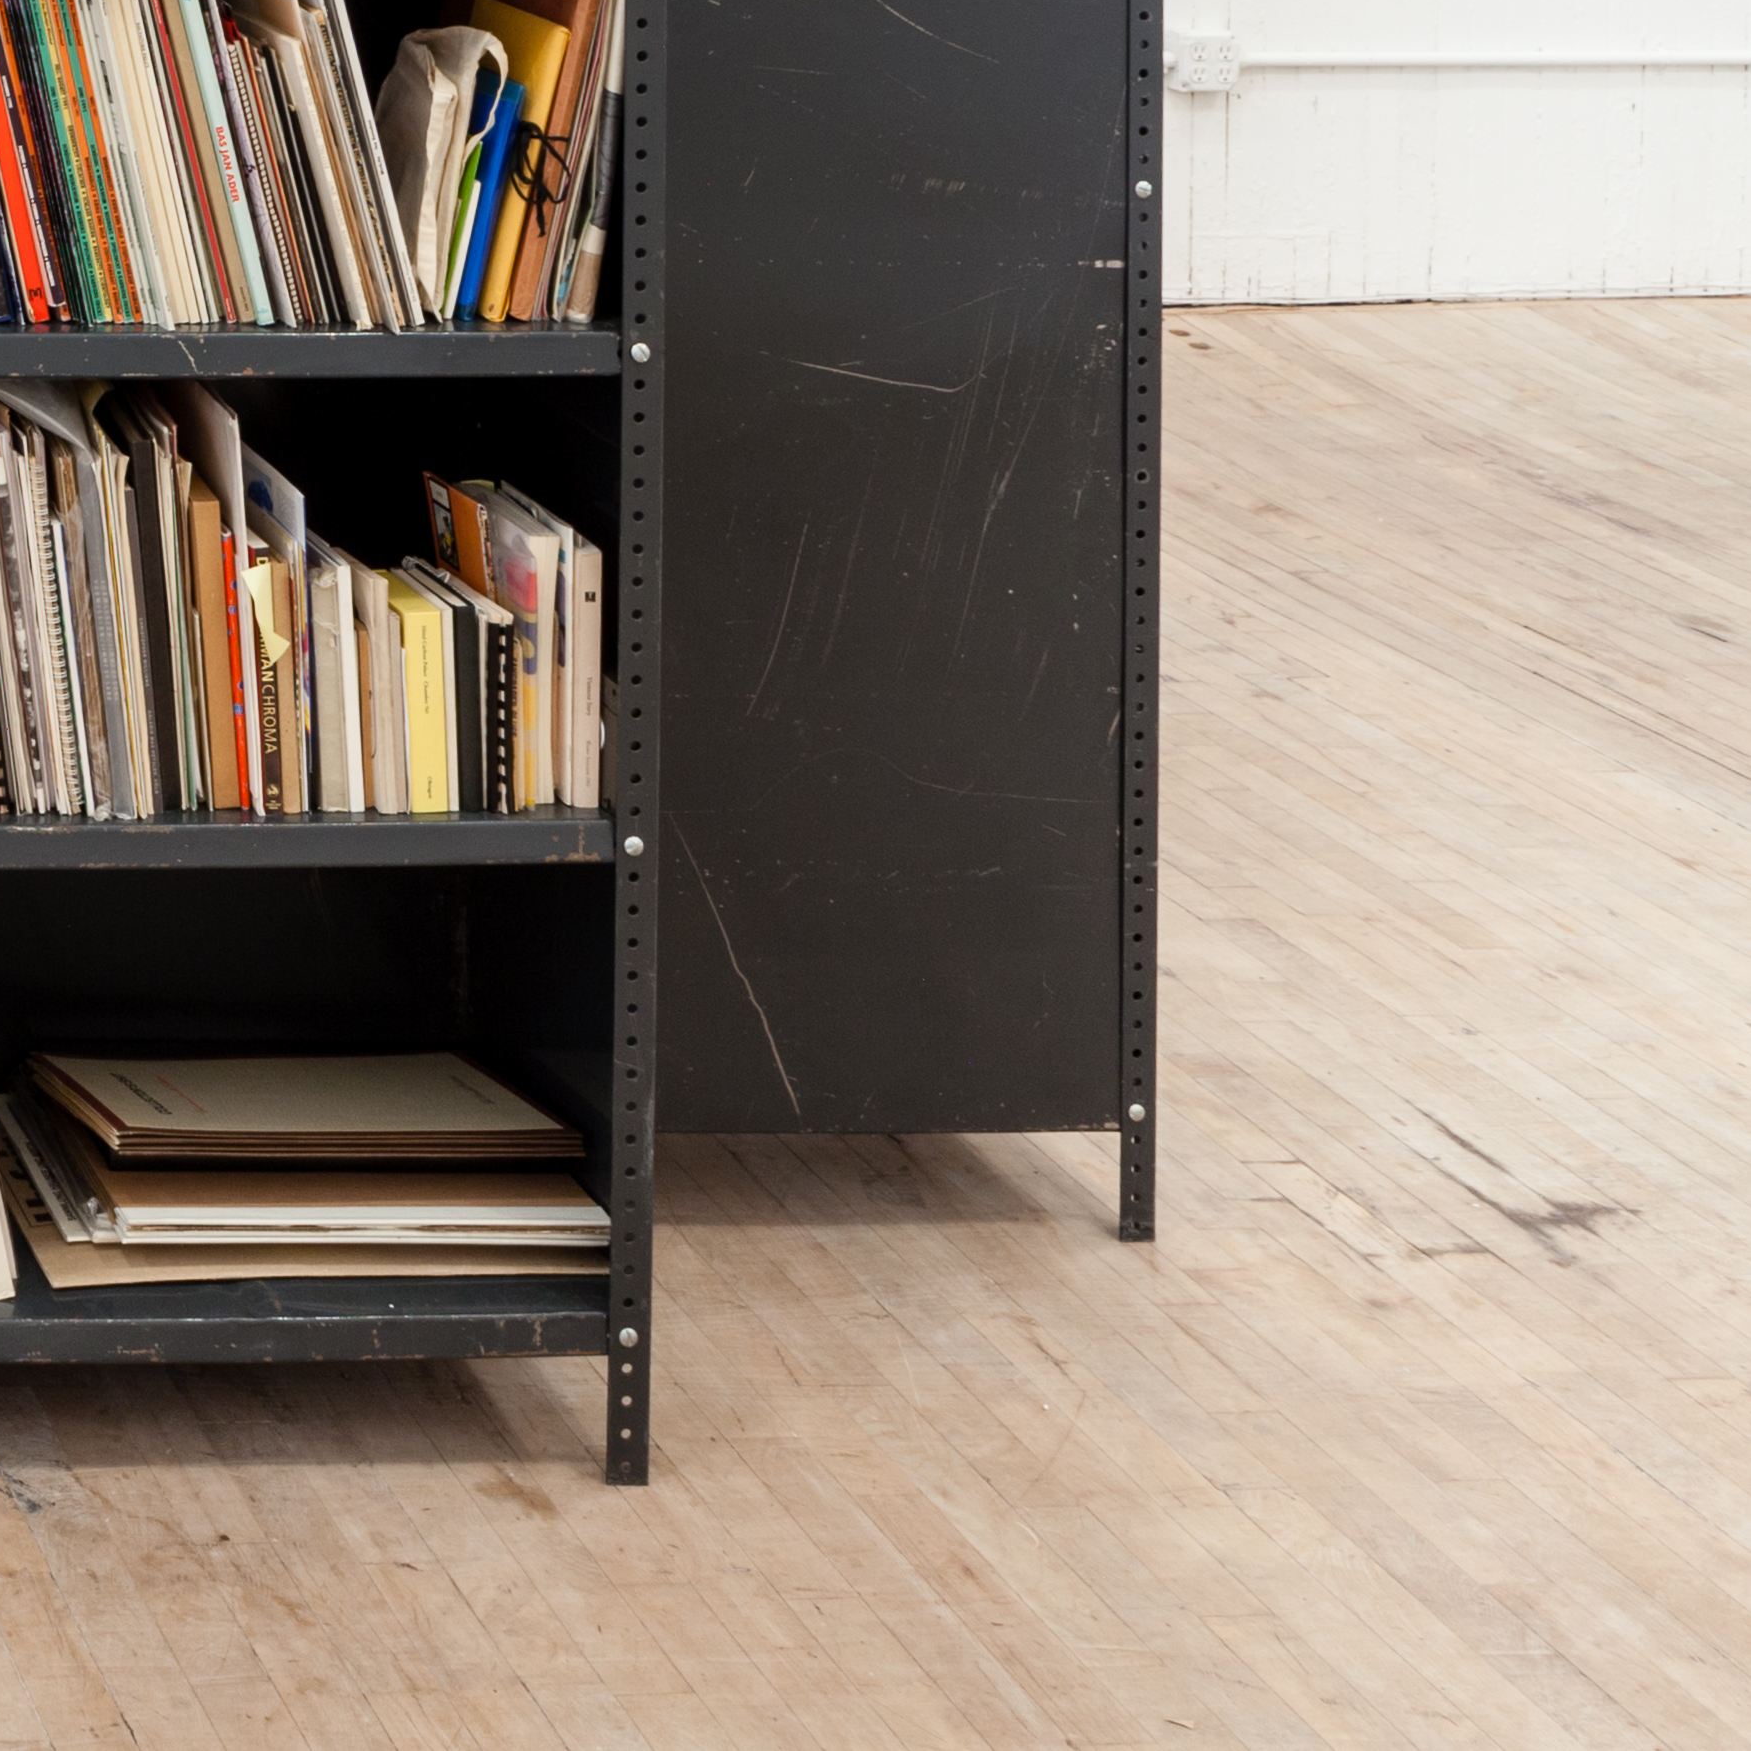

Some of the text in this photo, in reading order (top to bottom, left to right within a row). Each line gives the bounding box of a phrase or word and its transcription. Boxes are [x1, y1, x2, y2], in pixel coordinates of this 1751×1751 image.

[215, 126, 239, 202] BAS JAN ADER
[261, 685, 277, 753] CHROMA
